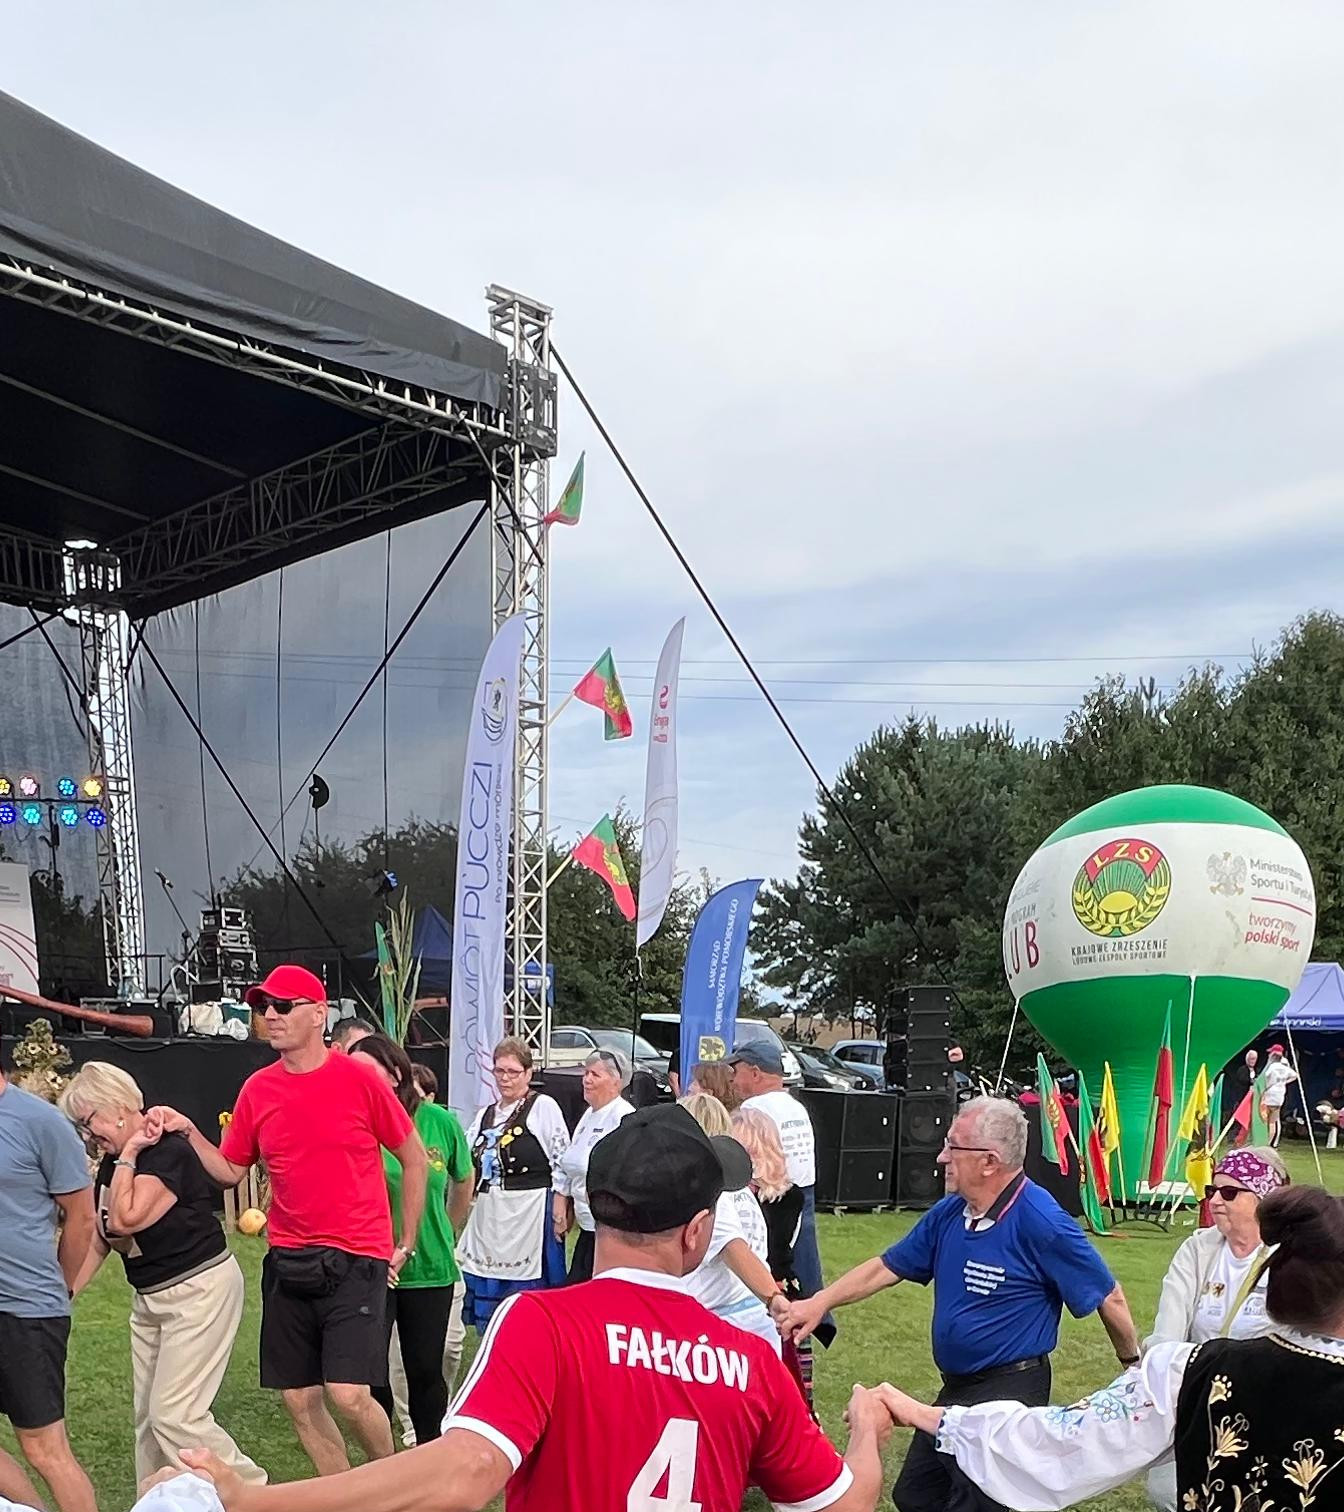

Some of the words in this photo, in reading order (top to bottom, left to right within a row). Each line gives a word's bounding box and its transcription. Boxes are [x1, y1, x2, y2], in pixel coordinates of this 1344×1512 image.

[1092, 842, 1154, 868] LZS
[1251, 873, 1284, 891] Sportu
[1071, 943, 1109, 957] KRAJOWE
[1112, 939, 1168, 952] ZRZESZENIE
[1245, 928, 1280, 946] polski
[1280, 936, 1300, 952] sport
[605, 1323, 749, 1393] FAŁKÓW
